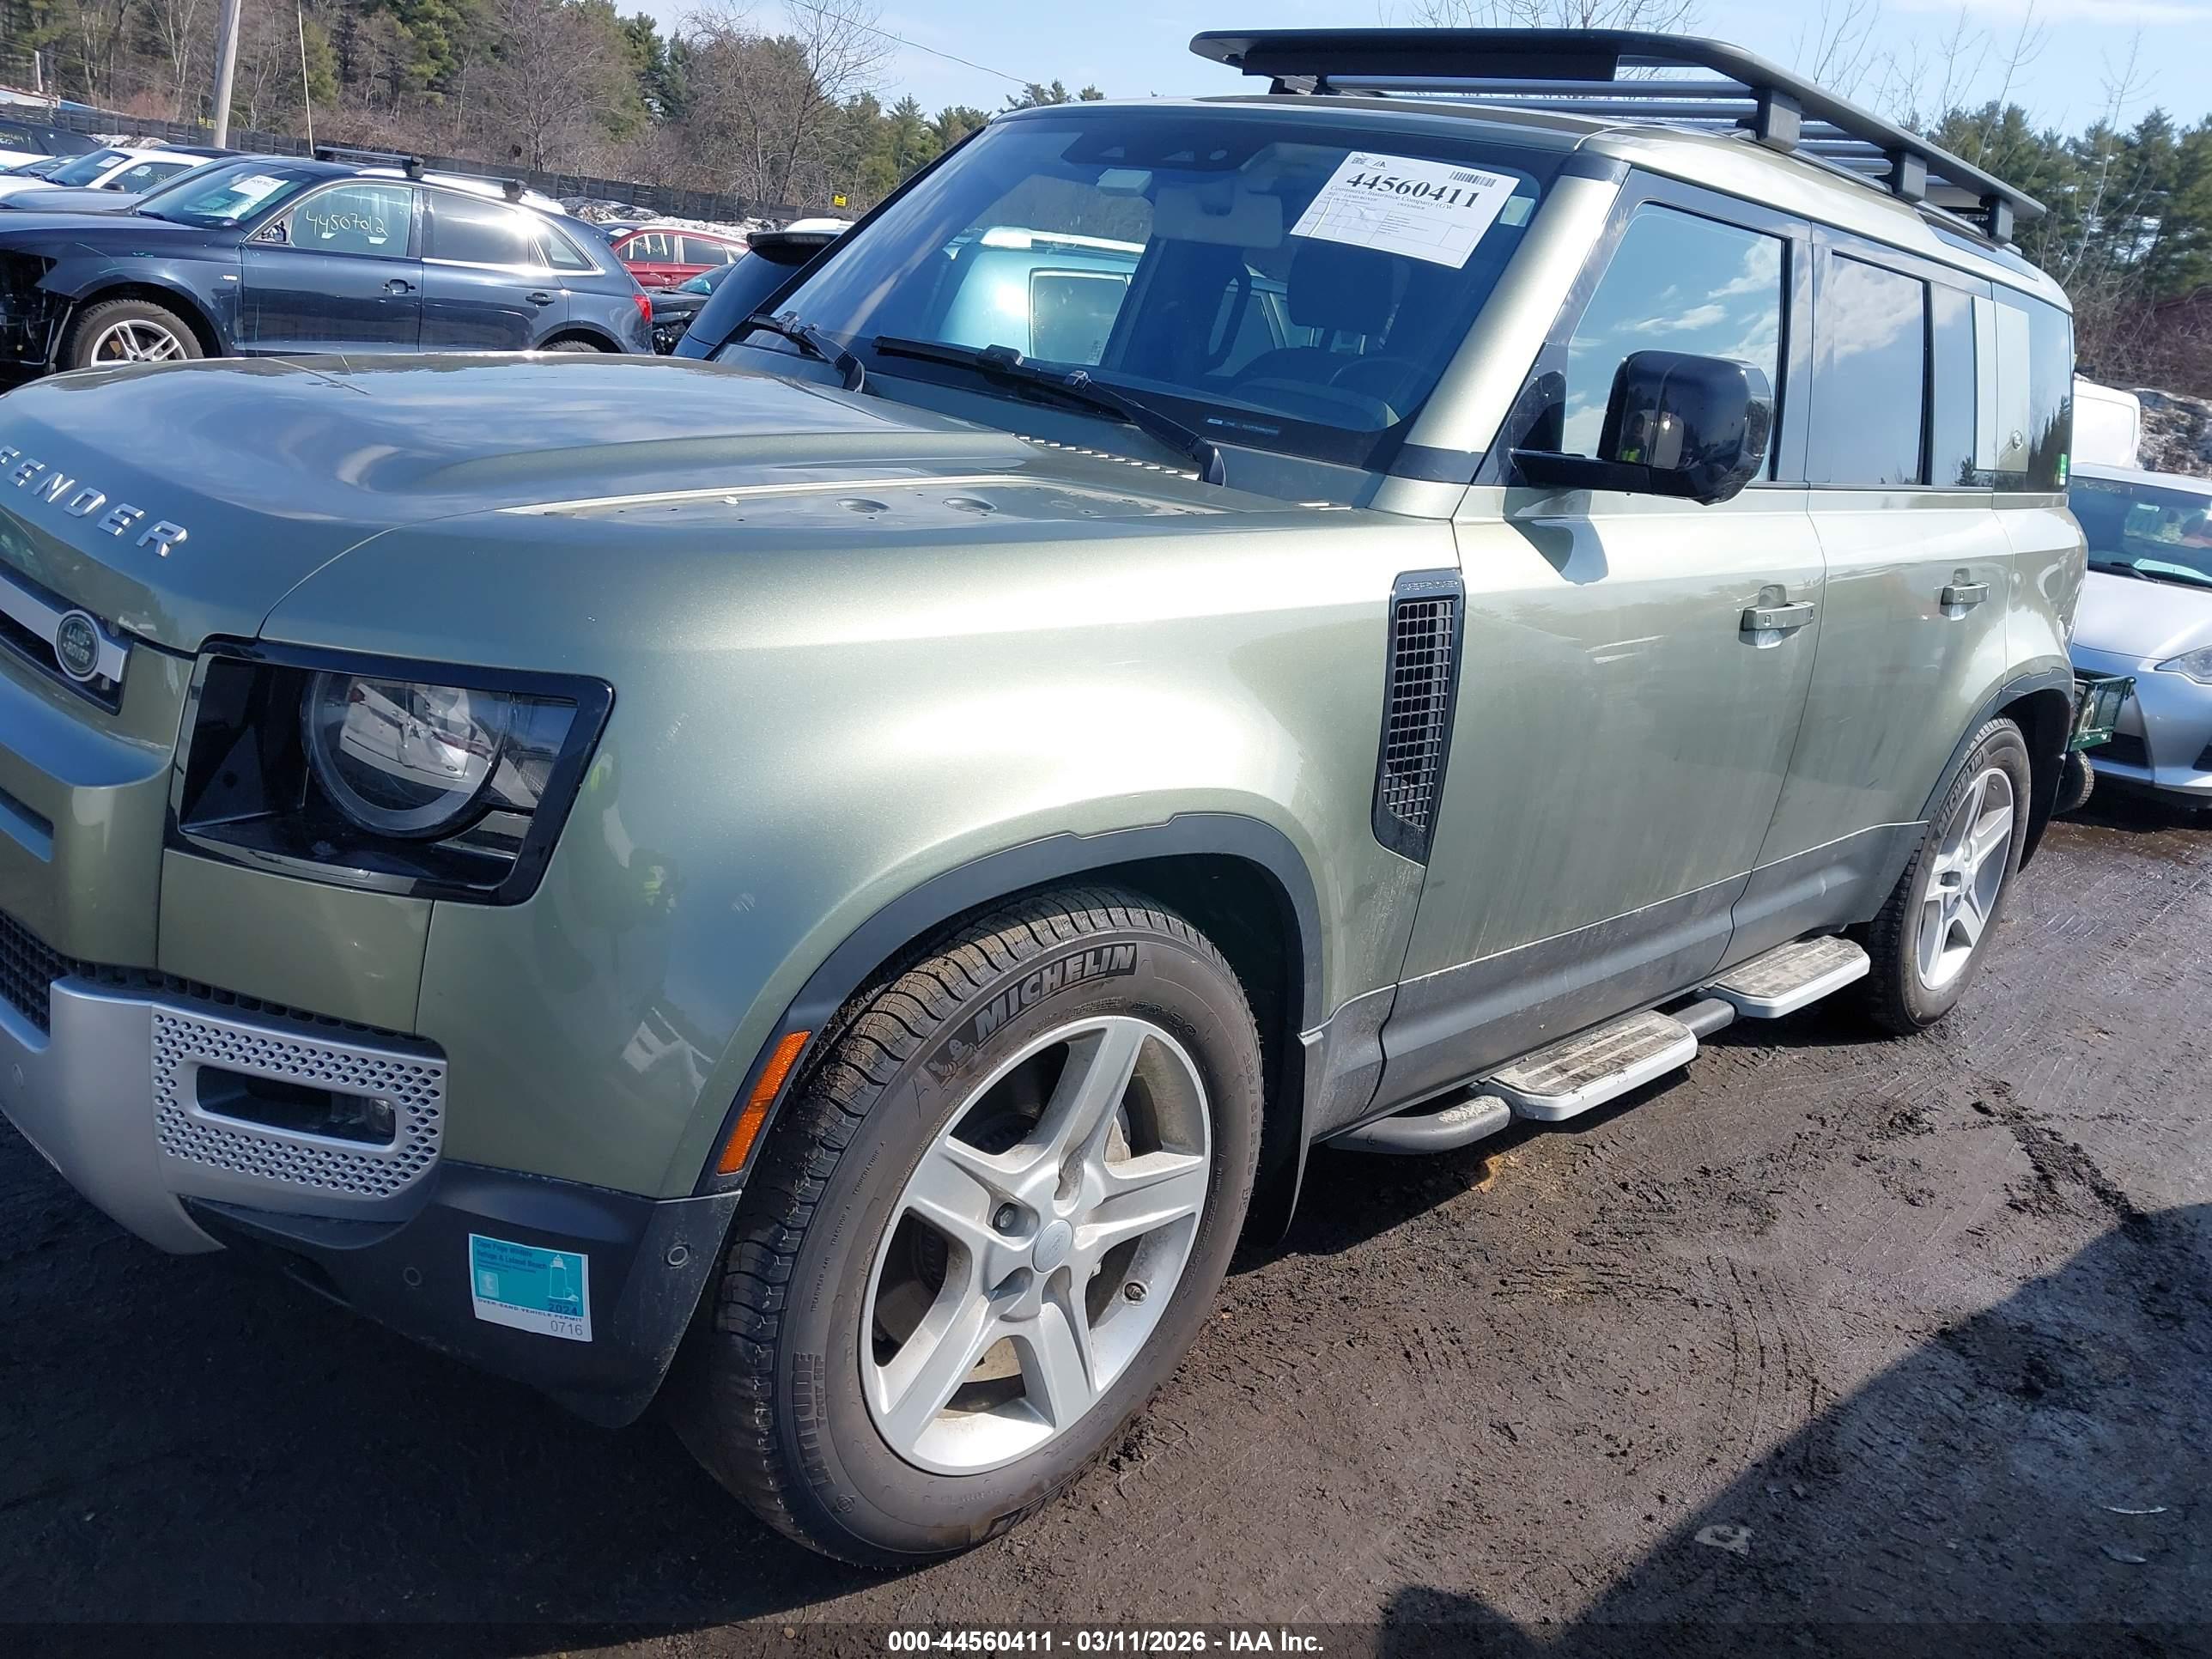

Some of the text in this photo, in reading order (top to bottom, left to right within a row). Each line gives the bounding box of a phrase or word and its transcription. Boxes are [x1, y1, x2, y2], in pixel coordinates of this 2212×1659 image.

[1346, 172, 1480, 208] 44560411
[1401, 196, 1433, 205] Company
[306, 210, 389, 237] 44507012
[1937, 750, 1984, 837] MICHELIN
[975, 945, 1135, 1042] MICHELIN
[831, 1213, 847, 1246] TRACTION
[550, 1303, 578, 1316] 2024
[554, 1314, 583, 1322] PERMIT
[550, 1321, 583, 1336] 0716
